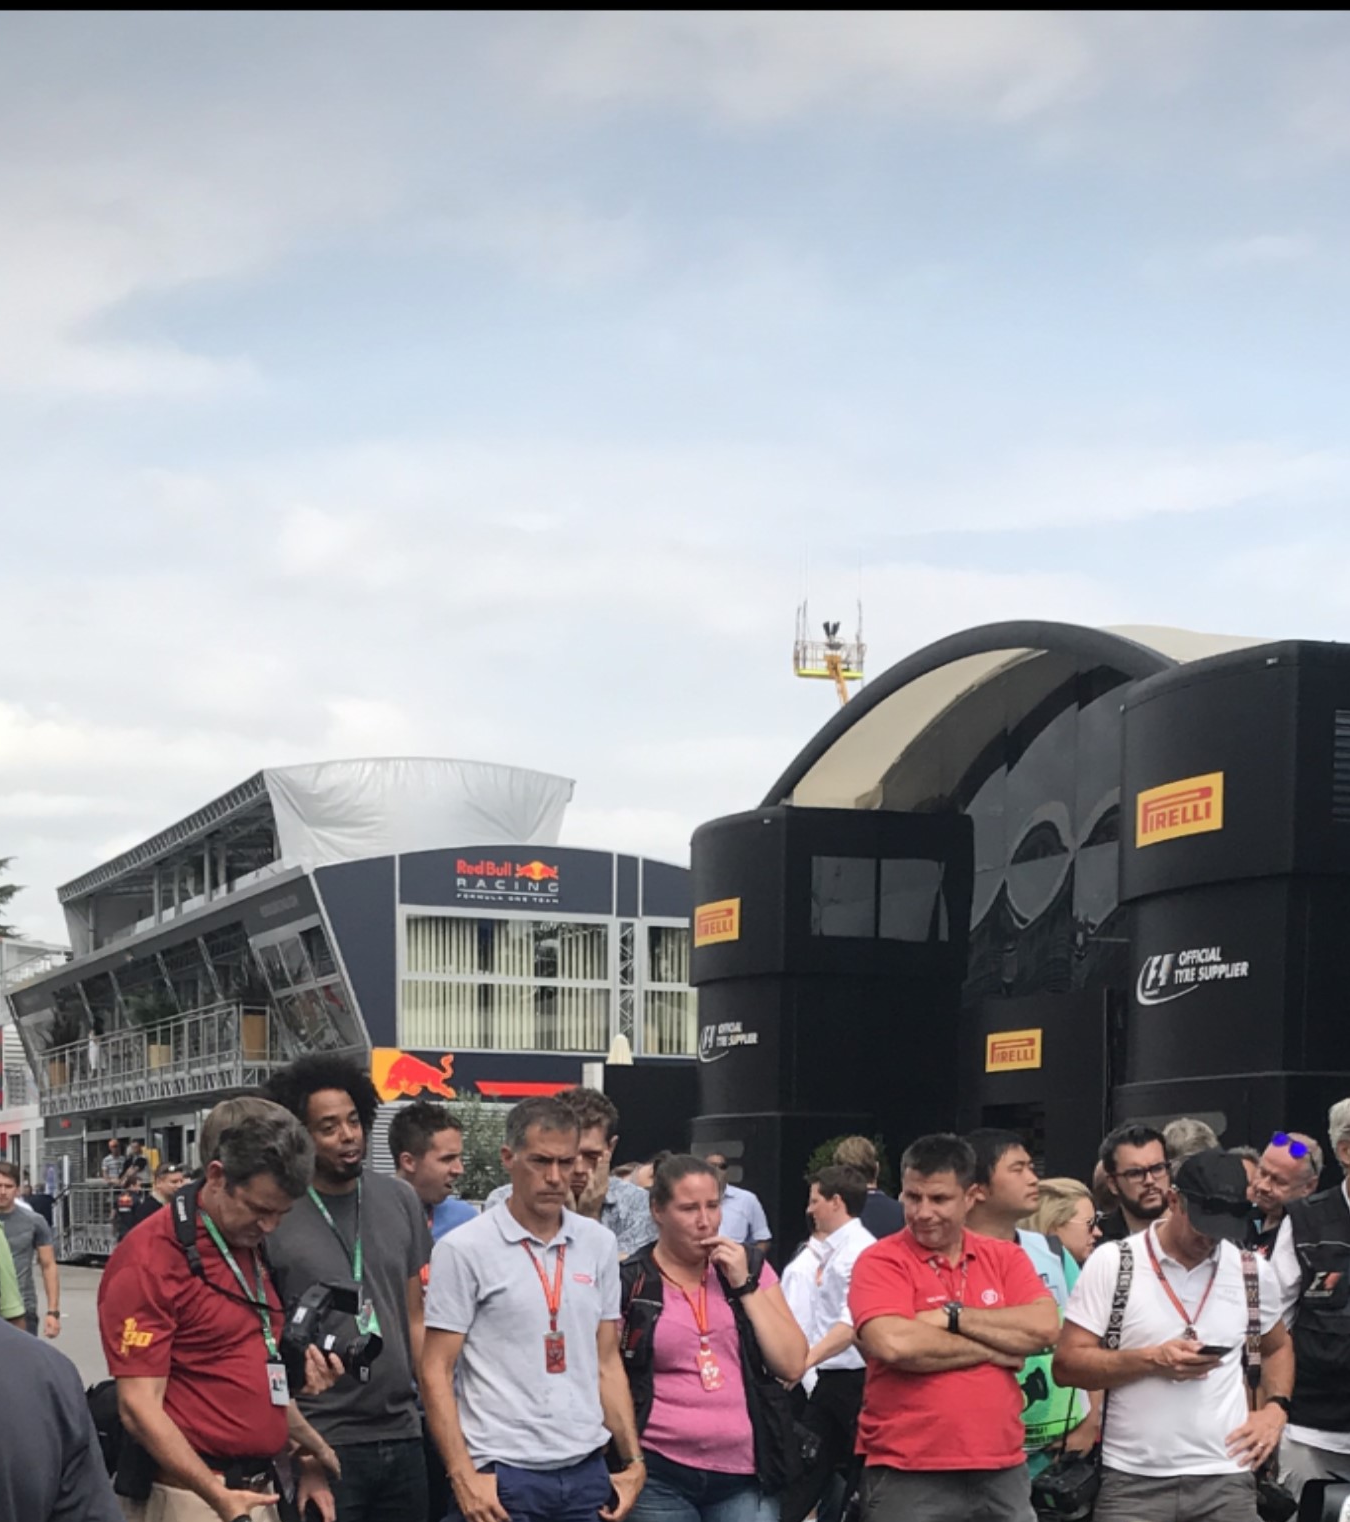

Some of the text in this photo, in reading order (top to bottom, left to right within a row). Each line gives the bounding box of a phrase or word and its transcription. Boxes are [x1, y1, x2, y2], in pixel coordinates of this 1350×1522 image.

[1141, 785, 1213, 835] PIRELLI
[456, 858, 512, 877] Red Bull
[456, 877, 559, 893] RACING
[1178, 946, 1222, 967] OFFICIAL
[1174, 961, 1249, 985] TYRE SUPPLIER
[990, 1037, 1036, 1065] PIRELLI
